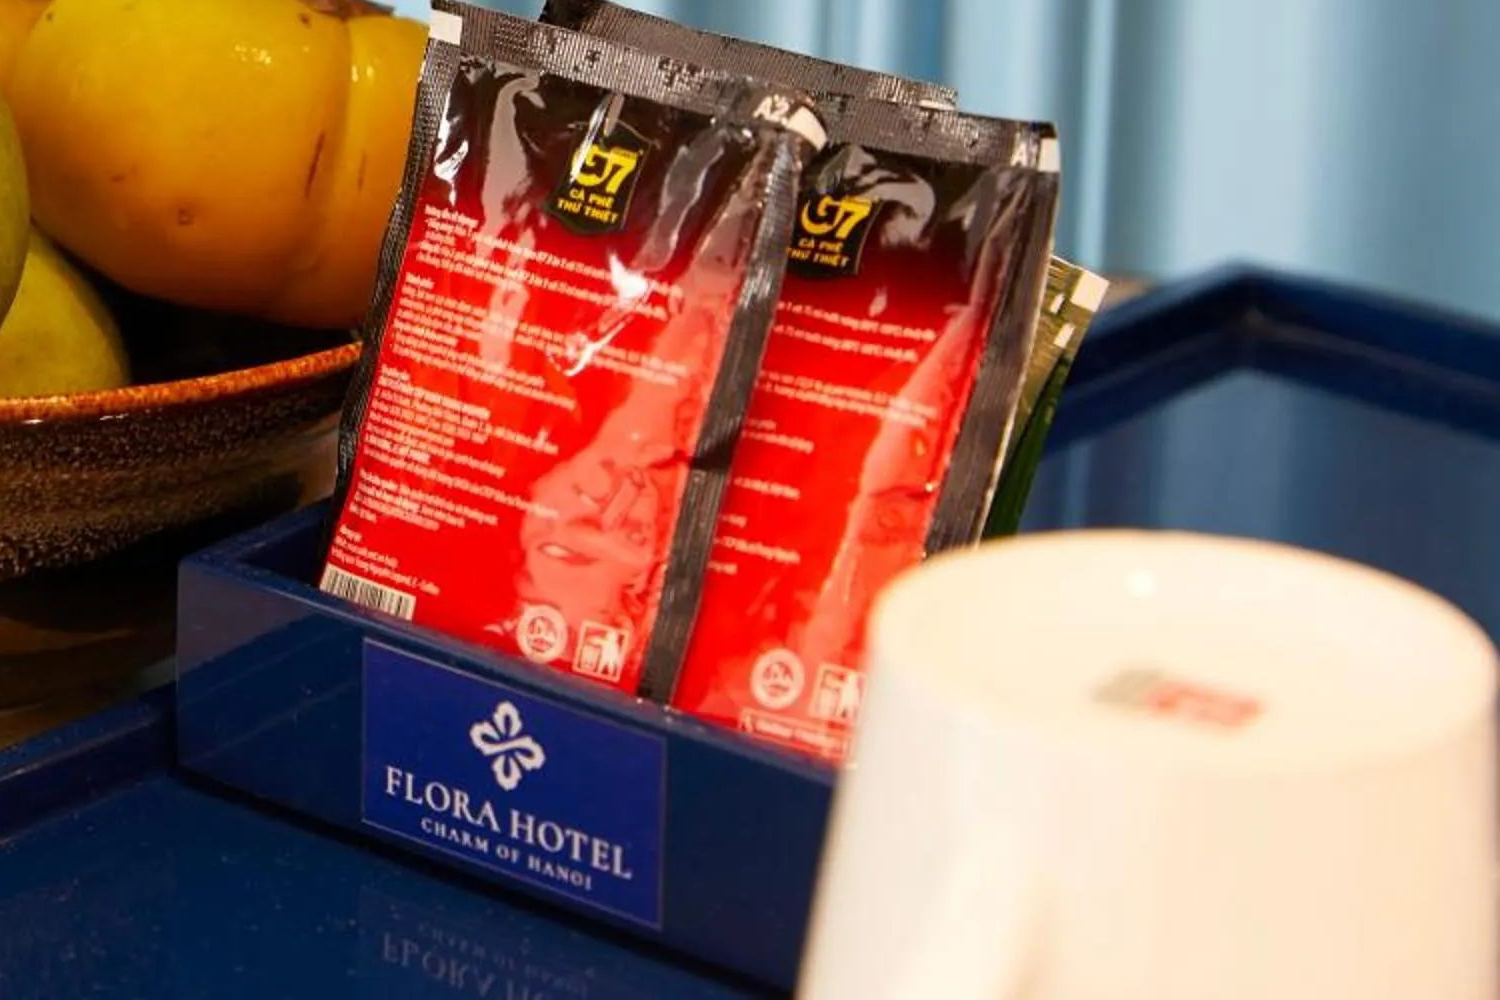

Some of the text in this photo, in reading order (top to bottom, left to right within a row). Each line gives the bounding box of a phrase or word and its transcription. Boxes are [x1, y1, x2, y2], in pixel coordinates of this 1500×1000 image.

[570, 144, 638, 195] G7
[801, 194, 873, 239] G7
[385, 765, 633, 881] FLORA HOTEL
[420, 817, 593, 891] CHARM OF HANOI
